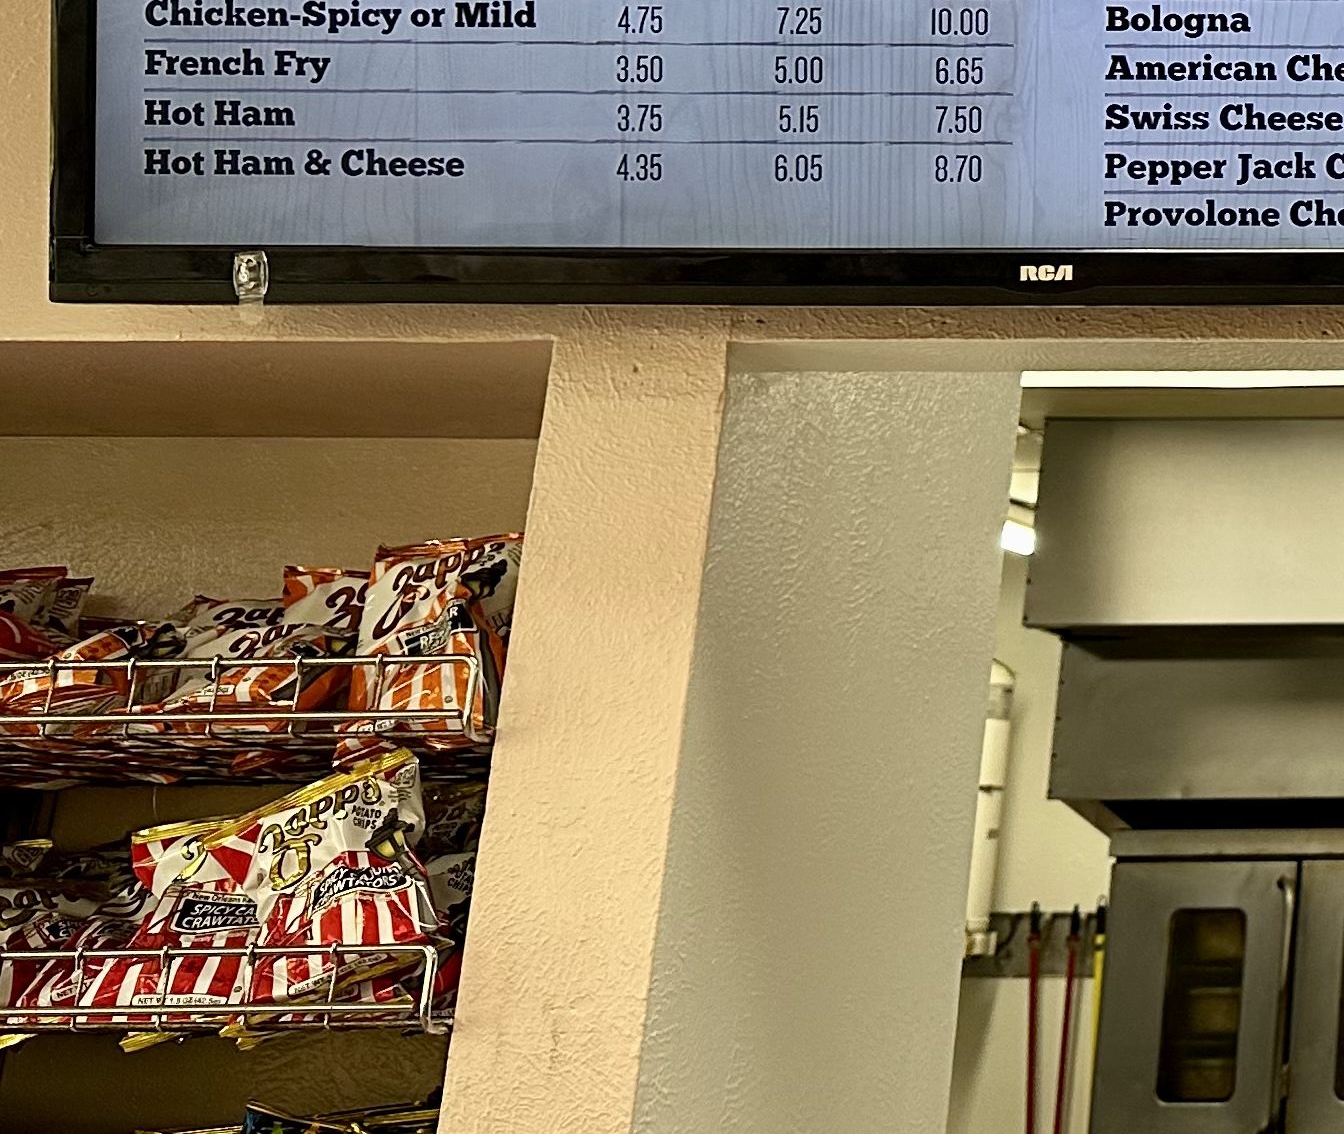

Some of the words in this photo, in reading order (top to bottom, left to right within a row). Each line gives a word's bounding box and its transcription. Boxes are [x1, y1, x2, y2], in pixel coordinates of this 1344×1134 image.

[144, 148, 205, 176] Hot
[213, 149, 295, 176] Ham
[304, 149, 332, 176] &
[341, 148, 465, 177] Cheese
[616, 153, 662, 181] 4.35
[774, 154, 823, 182] 6.05
[935, 154, 982, 183] 8.70
[1104, 199, 1280, 227] Provolone
[1020, 265, 1073, 281] RCA
[352, 805, 382, 819] POTATO
[190, 903, 237, 916] SPICY
